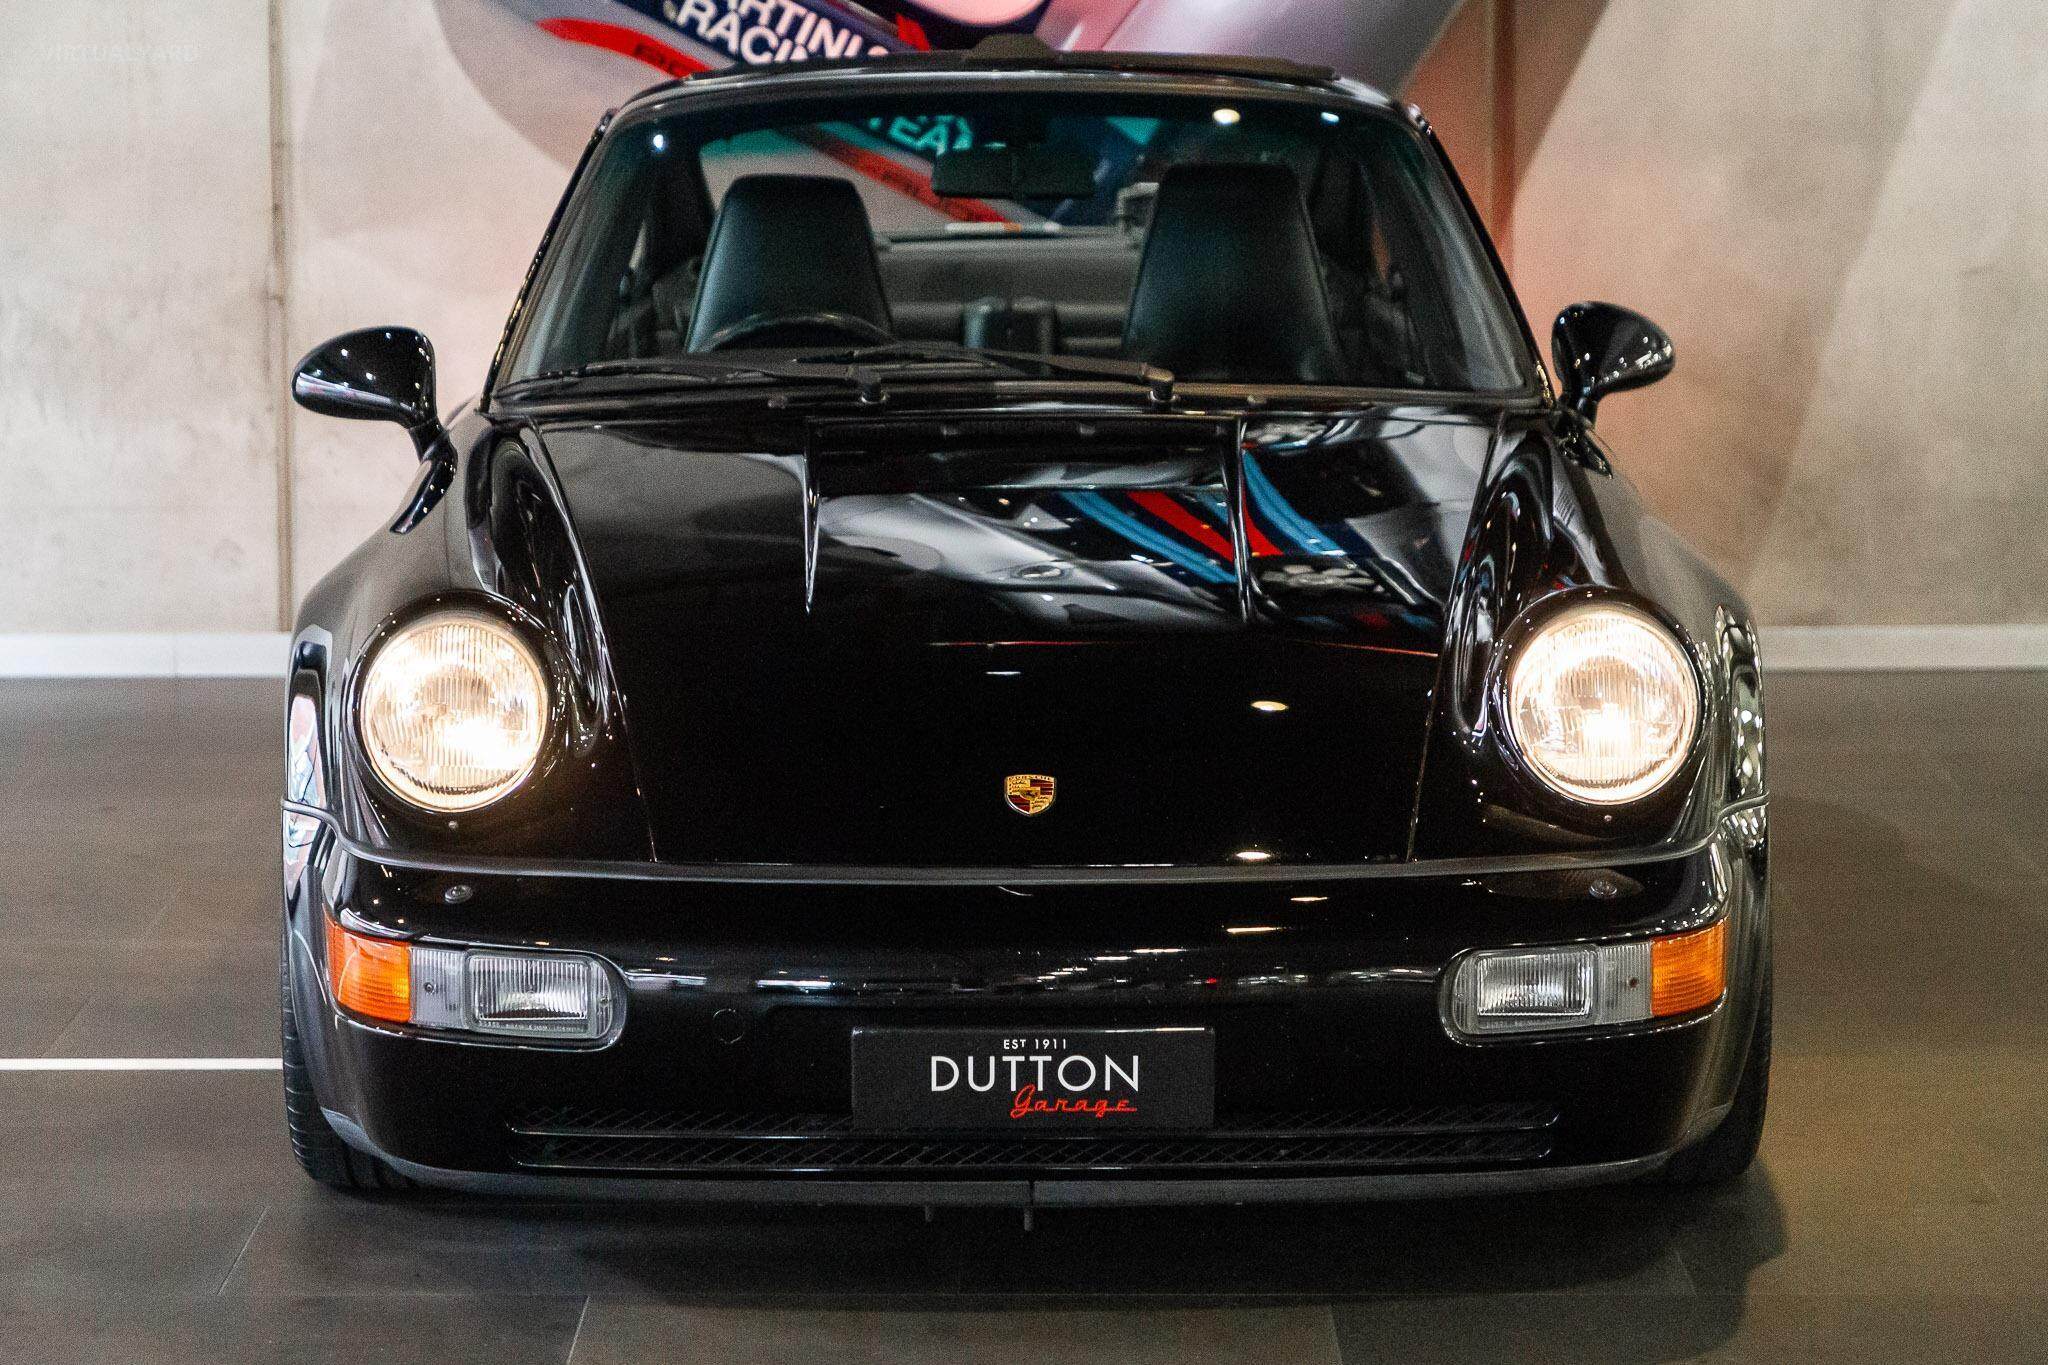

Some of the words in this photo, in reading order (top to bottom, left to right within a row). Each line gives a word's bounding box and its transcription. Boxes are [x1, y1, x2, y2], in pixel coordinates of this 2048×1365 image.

[676, 0, 809, 65] RACI
[1003, 1038, 1027, 1050] EST
[1034, 1038, 1067, 1050] 1911
[930, 1055, 1139, 1092] DUTTON
[1010, 1084, 1138, 1119] Garage
